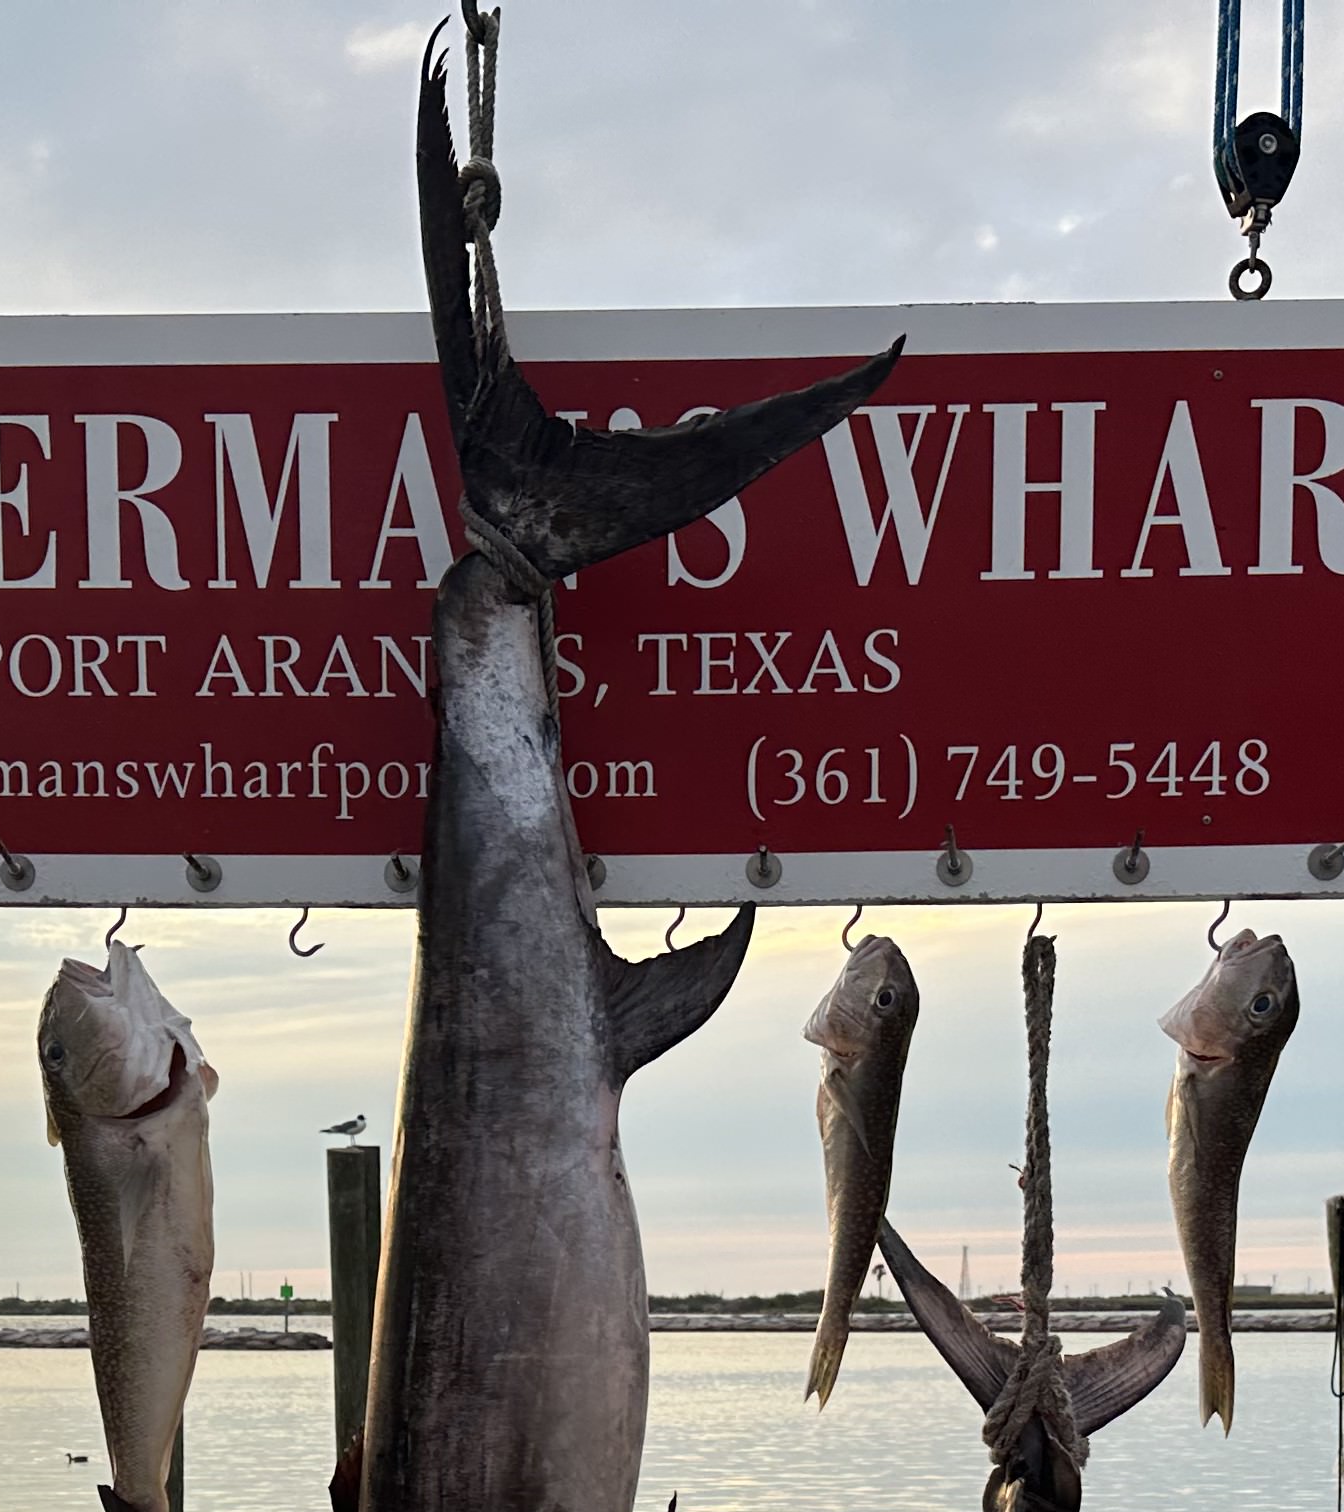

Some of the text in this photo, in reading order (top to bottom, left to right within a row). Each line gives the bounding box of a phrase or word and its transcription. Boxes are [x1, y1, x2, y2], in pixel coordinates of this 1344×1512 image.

[195, 633, 609, 708] ARANS,
[638, 628, 902, 695] TEXAS
[746, 733, 918, 821] (361)
[946, 738, 1270, 801] 749-5448
